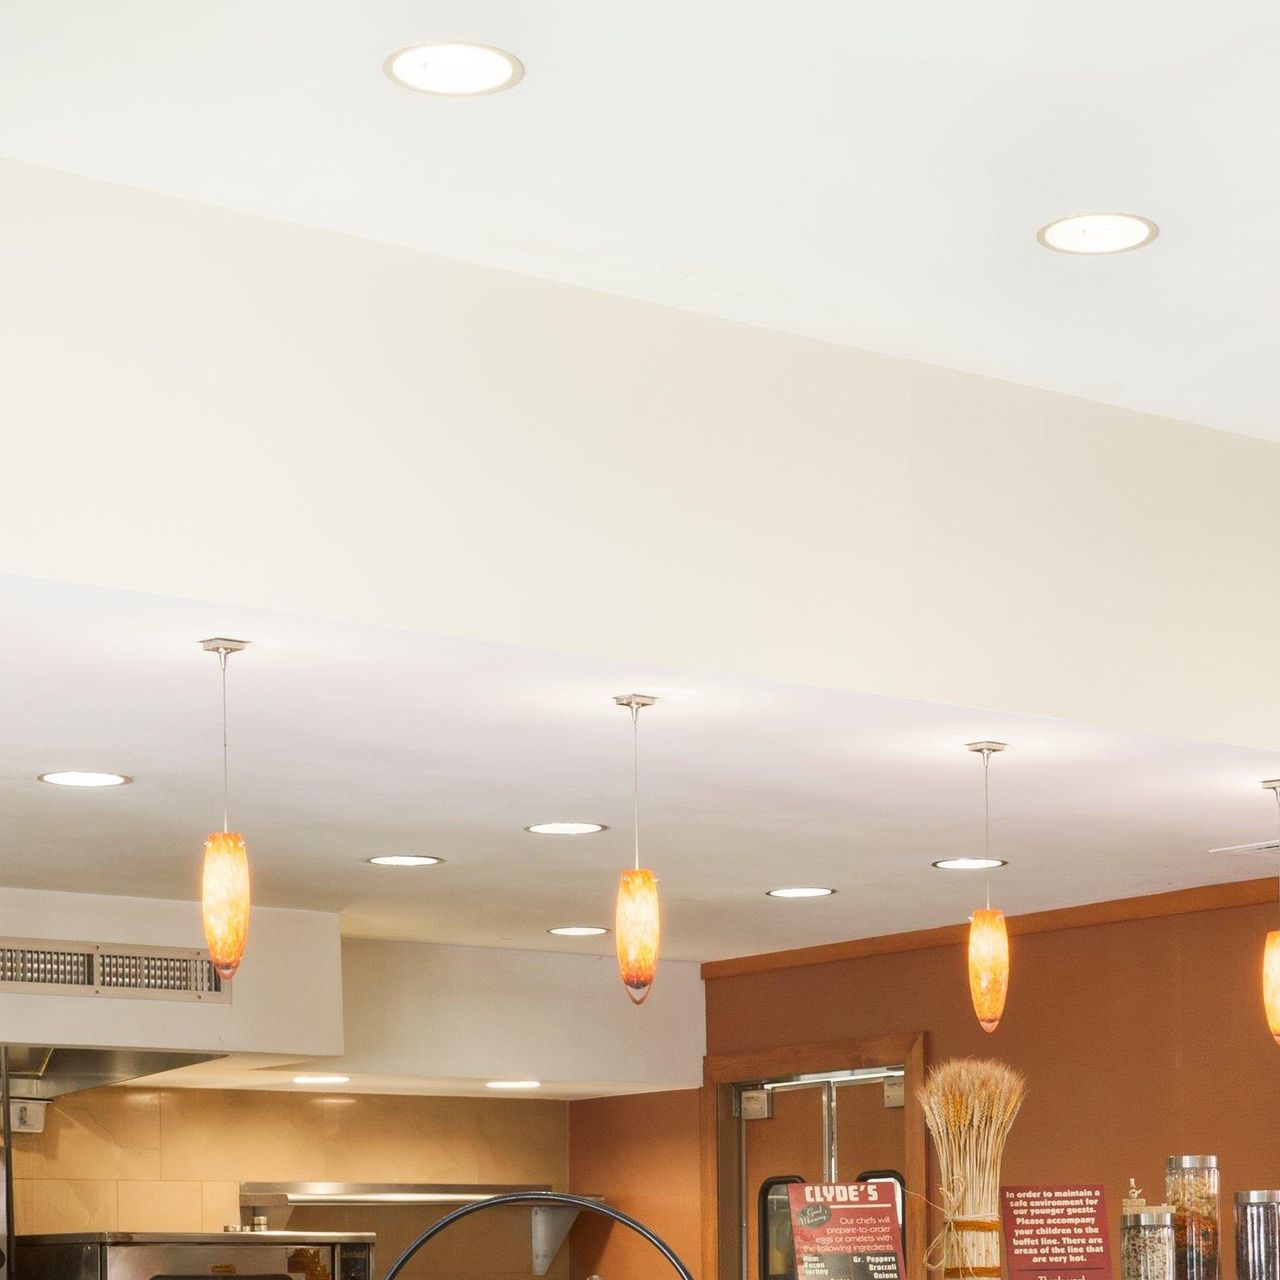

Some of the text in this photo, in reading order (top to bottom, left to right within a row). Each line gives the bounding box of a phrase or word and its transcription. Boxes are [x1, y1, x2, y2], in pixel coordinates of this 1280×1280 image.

[805, 1184, 878, 1202] CLYDE'S
[1054, 1189, 1092, 1198] maintain
[1030, 1208, 1064, 1216] younger
[1066, 1207, 1096, 1215] guests.
[878, 1216, 890, 1224] will
[1085, 1226, 1100, 1234] the
[1012, 1238, 1038, 1246] buffet
[818, 1245, 852, 1253] following
[853, 1244, 894, 1252] ingredients
[1040, 1246, 1050, 1254] of
[1052, 1246, 1065, 1254] the
[1070, 1254, 1086, 1262] hot.
